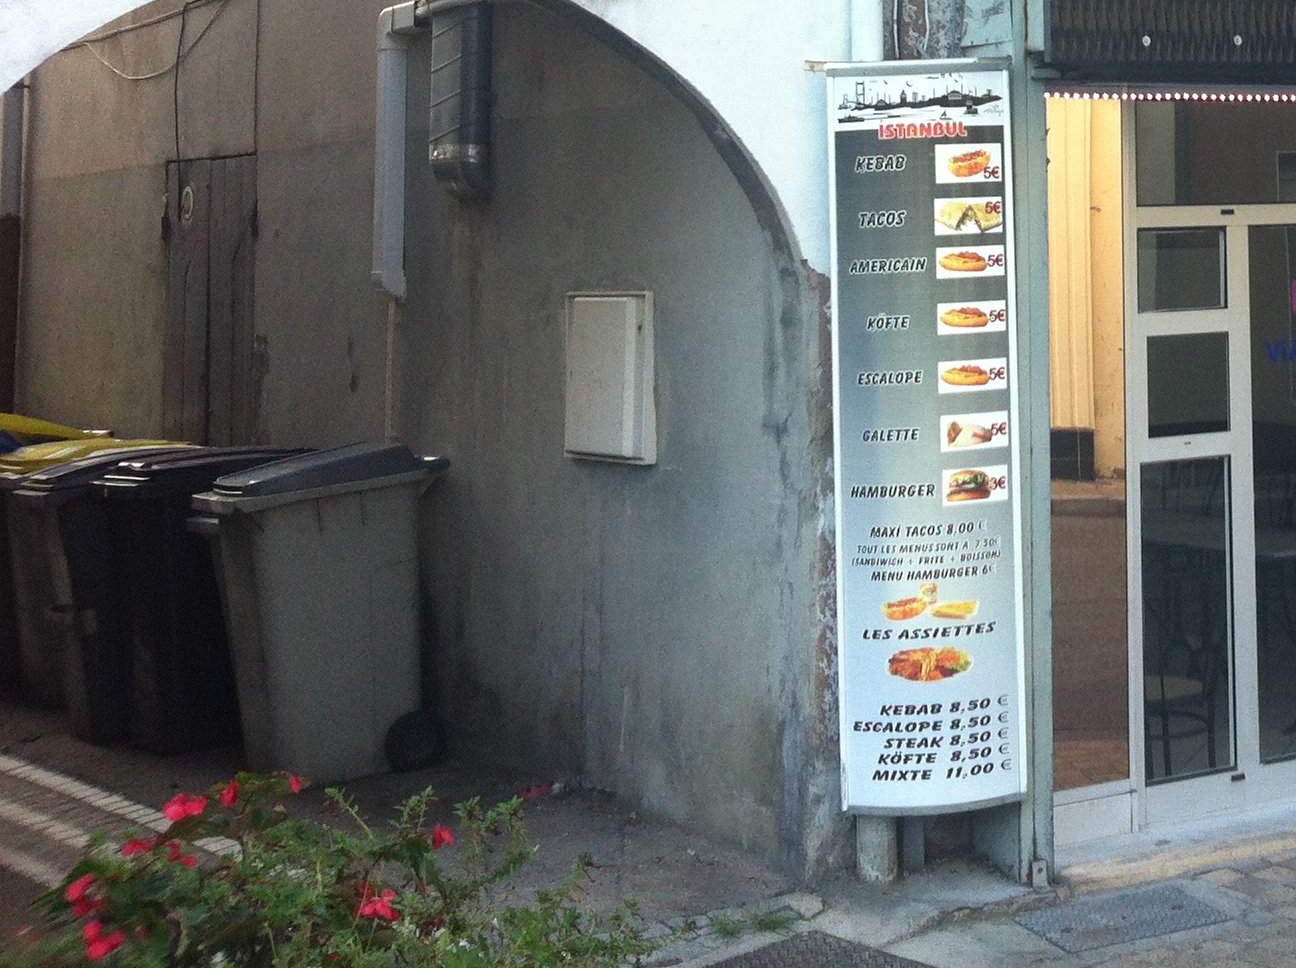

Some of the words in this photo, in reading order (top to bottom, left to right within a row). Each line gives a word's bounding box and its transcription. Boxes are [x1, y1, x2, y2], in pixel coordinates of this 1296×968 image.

[855, 155, 906, 173] KEBAB
[983, 166, 1000, 179] 5€
[985, 201, 1001, 214] 5€
[858, 211, 905, 228] TACOS
[850, 258, 926, 275] AMERICAIN
[987, 254, 1003, 267] 5€
[988, 309, 1006, 322] 5€
[857, 370, 922, 386] ESCALOPE
[989, 367, 1005, 380] 5€
[862, 428, 920, 442] GALETTE
[991, 422, 1007, 435] 5€
[850, 483, 935, 499] HAMBURGER
[906, 524, 942, 537] TACOS
[857, 545, 877, 554] TOUT
[881, 544, 896, 553] LES
[900, 543, 932, 553] MENUS
[935, 541, 959, 552] SONT
[918, 555, 944, 565] FRITE
[871, 570, 903, 582] MENU
[906, 566, 978, 581] HAMBURGER
[862, 629, 893, 641] LES
[897, 621, 997, 641] ASSIETTES
[879, 703, 943, 717] KEBAB
[948, 697, 991, 715] 8,50
[853, 720, 943, 734] ESCALOPE
[949, 714, 991, 732] 8,50
[883, 736, 944, 750] STEAK
[949, 730, 992, 748] 8,50
[877, 751, 937, 765] KÖFTE
[950, 746, 992, 764] 8,50
[872, 768, 932, 782] MIXTE
[946, 762, 995, 781] 11,00
